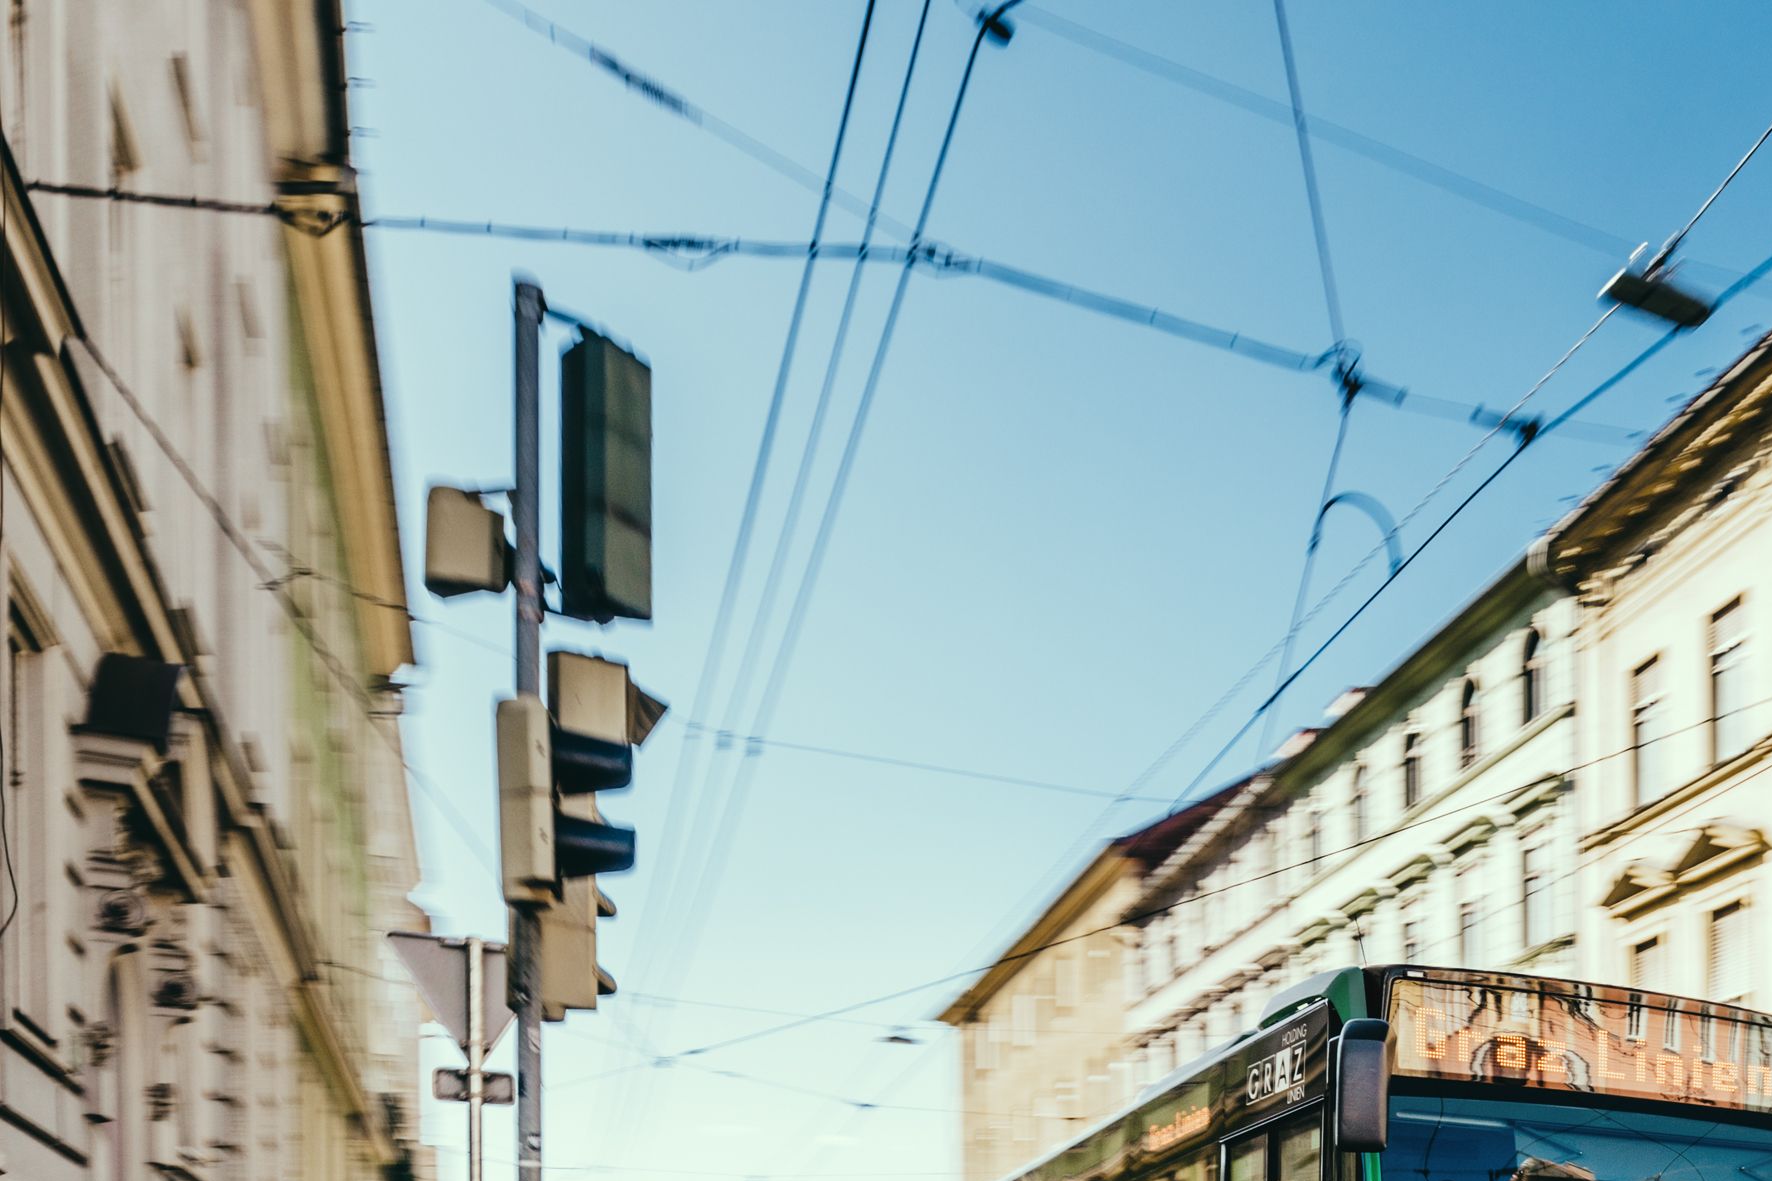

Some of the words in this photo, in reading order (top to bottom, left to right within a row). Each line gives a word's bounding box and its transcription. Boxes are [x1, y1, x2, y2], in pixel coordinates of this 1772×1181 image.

[1281, 1023, 1308, 1047] HOLDING
[1415, 1007, 1568, 1075] Graz
[1597, 1030, 1772, 1098] Linien
[1247, 1045, 1304, 1101] GRAZ
[1286, 1084, 1305, 1105] LINIEN
